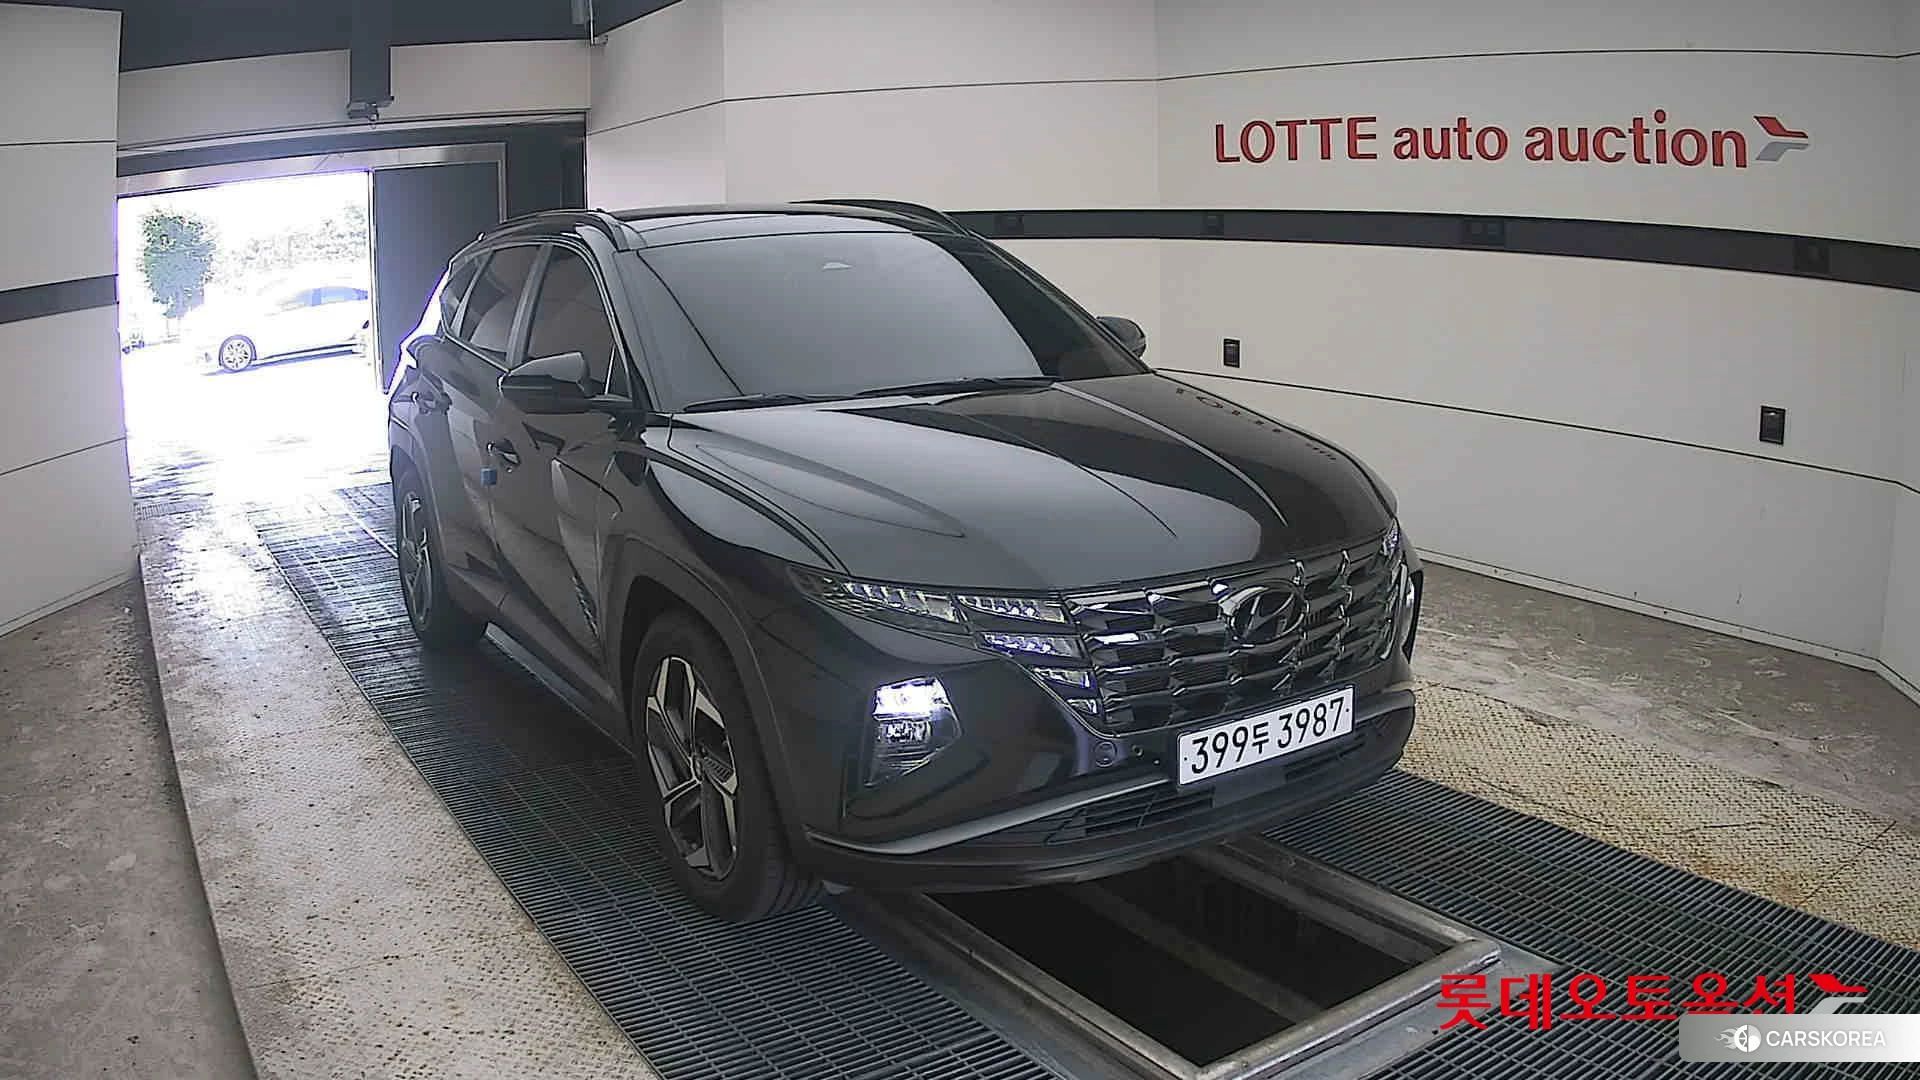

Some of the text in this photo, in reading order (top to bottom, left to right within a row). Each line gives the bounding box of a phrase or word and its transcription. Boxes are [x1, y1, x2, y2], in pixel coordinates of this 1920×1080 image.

[1215, 109, 1748, 168] LOTTE auto auction
[1191, 697, 1345, 775] 399두 3987
